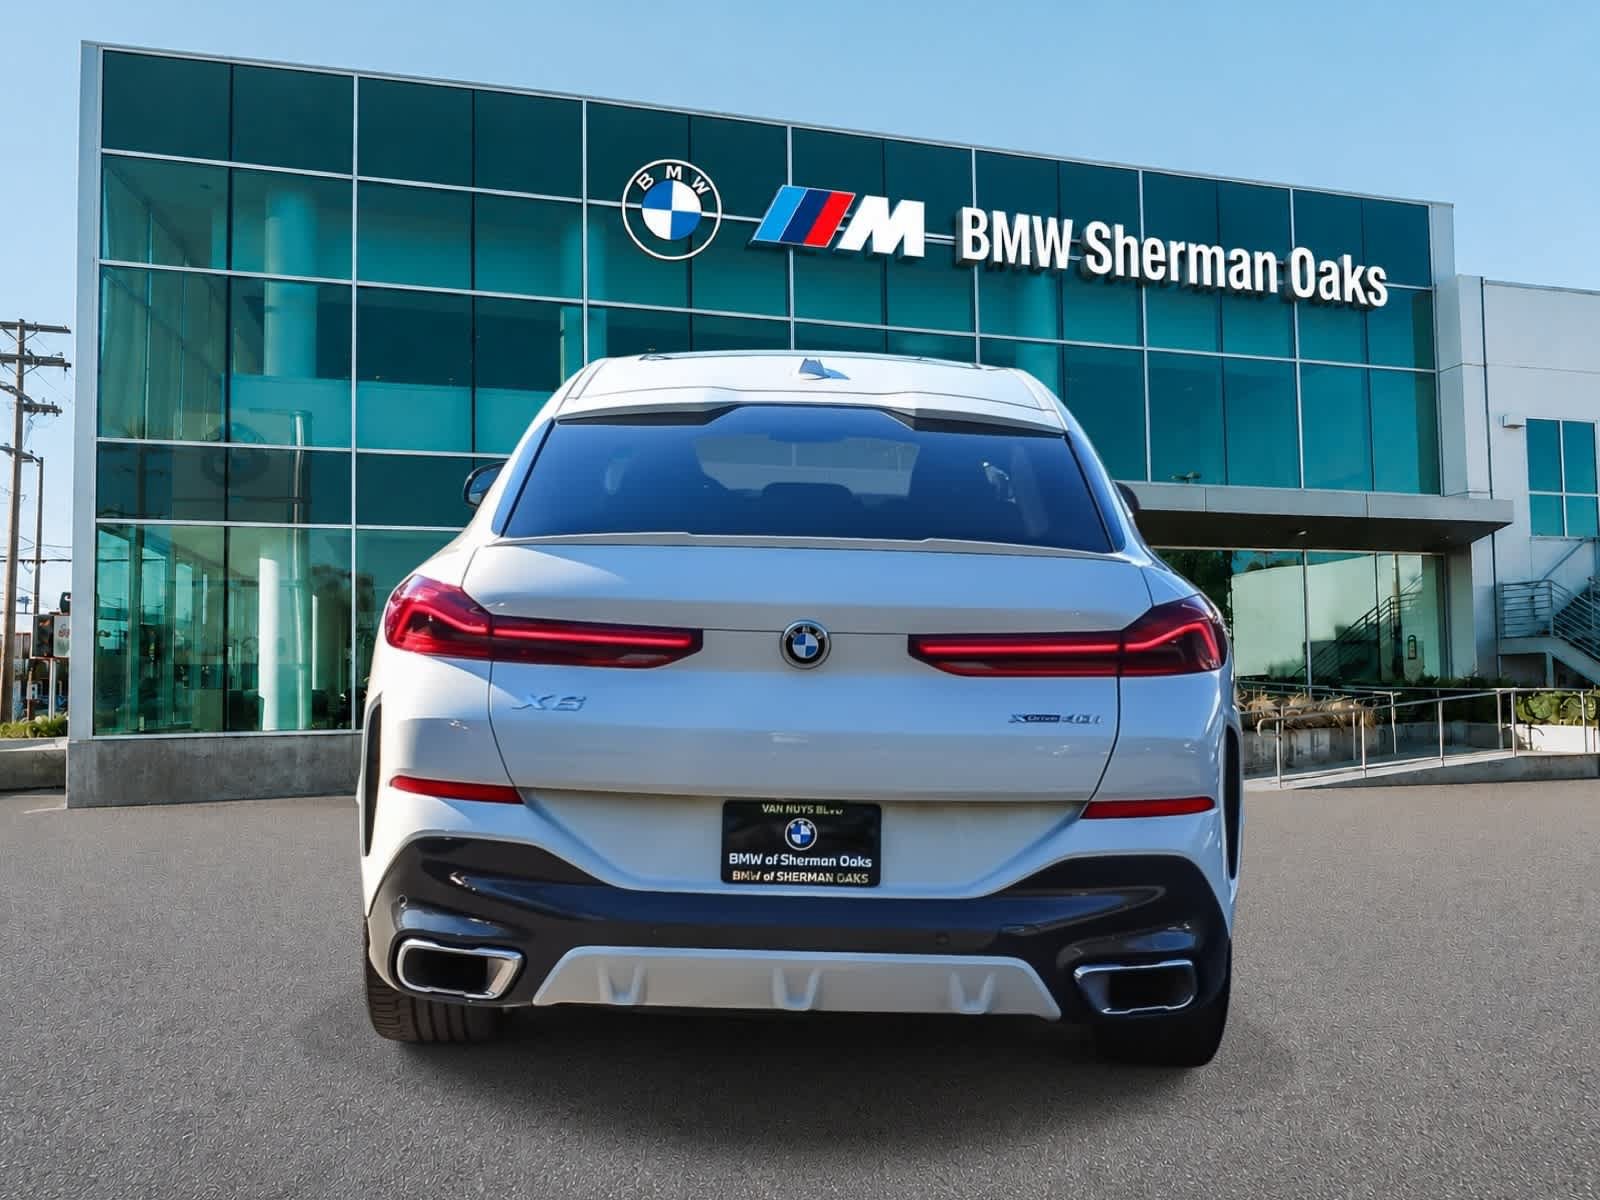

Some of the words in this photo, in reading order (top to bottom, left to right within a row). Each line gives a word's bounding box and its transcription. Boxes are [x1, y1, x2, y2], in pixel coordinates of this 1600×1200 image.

[636, 165, 711, 195] BMW
[959, 206, 1073, 270] BMW
[1085, 221, 1278, 293] Sherman
[1290, 246, 1389, 308] Oaks
[762, 803, 783, 814] VAN
[786, 804, 813, 815] NUYS
[729, 853, 763, 865] BMW
[765, 854, 778, 865] of
[780, 854, 836, 867] Sherman
[839, 855, 872, 868] Oaks
[732, 871, 761, 881] BMW
[763, 871, 775, 881] of
[776, 871, 833, 882] SHERMAN
[836, 873, 869, 883] OAKS
